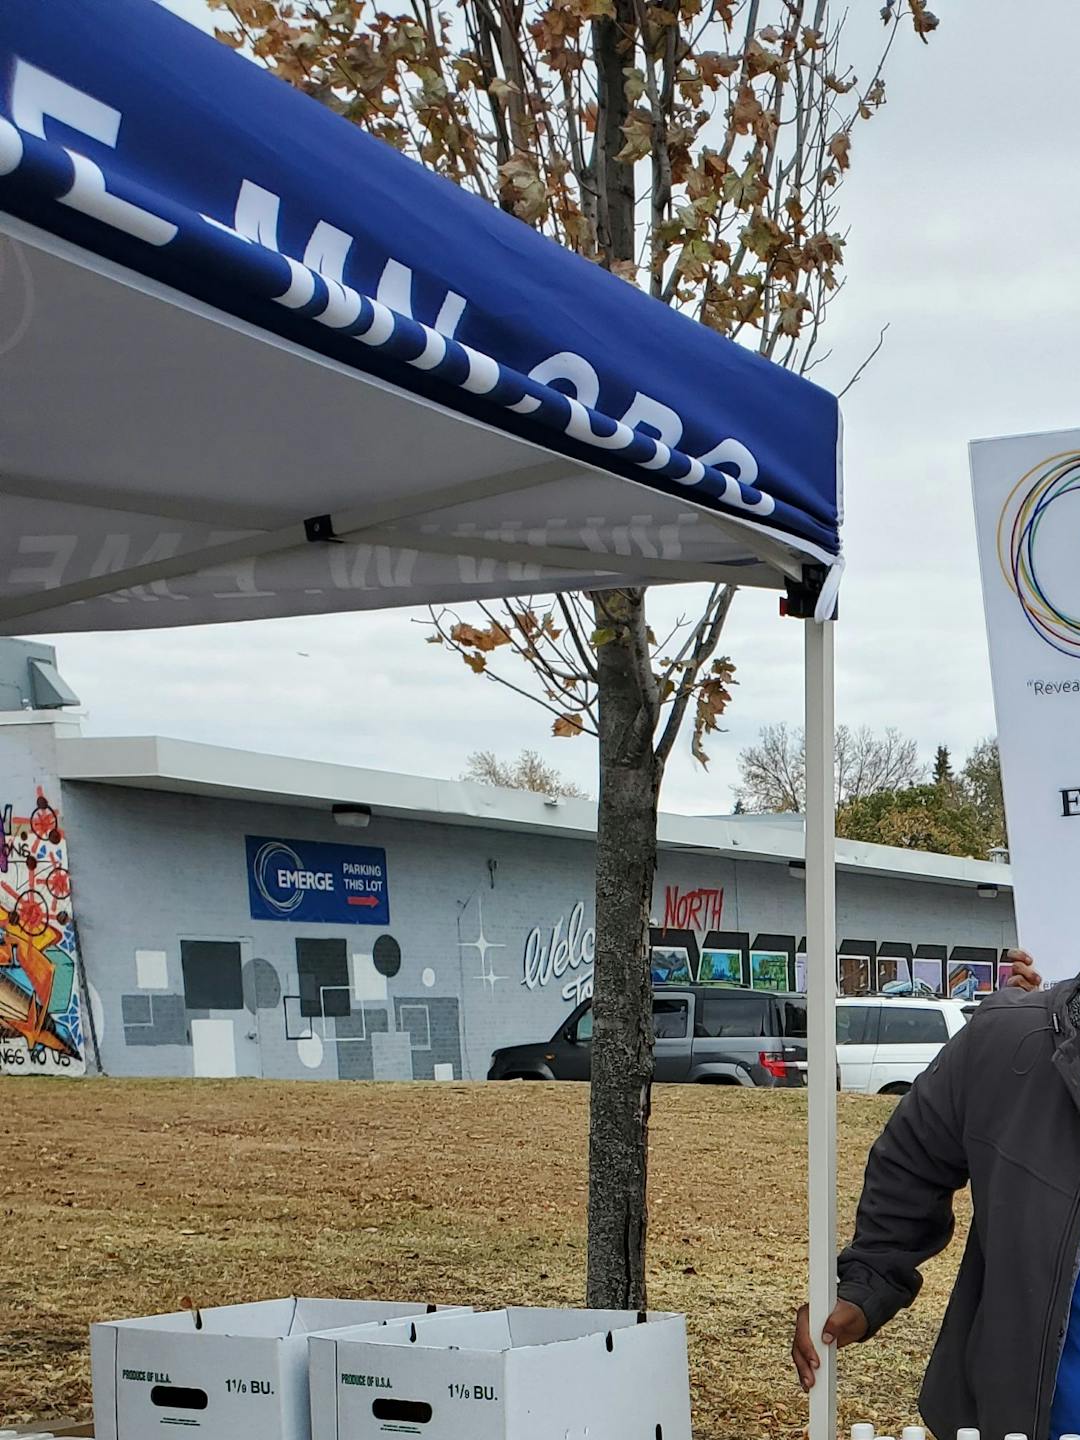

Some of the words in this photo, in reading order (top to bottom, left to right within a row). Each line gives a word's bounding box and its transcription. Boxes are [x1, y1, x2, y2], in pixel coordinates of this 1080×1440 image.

[343, 863, 382, 877] PARKING
[278, 869, 334, 891] EMERGE
[344, 879, 364, 891] THIS
[366, 880, 383, 892] LOT
[662, 886, 724, 939] NORTH
[521, 901, 596, 990] Welc
[122, 1369, 146, 1381] PRODUCE
[147, 1371, 155, 1382] OF
[341, 1373, 366, 1386] PRODUCE
[367, 1376, 375, 1387] OF
[250, 1380, 275, 1395] BU.
[473, 1385, 499, 1401] BU.
